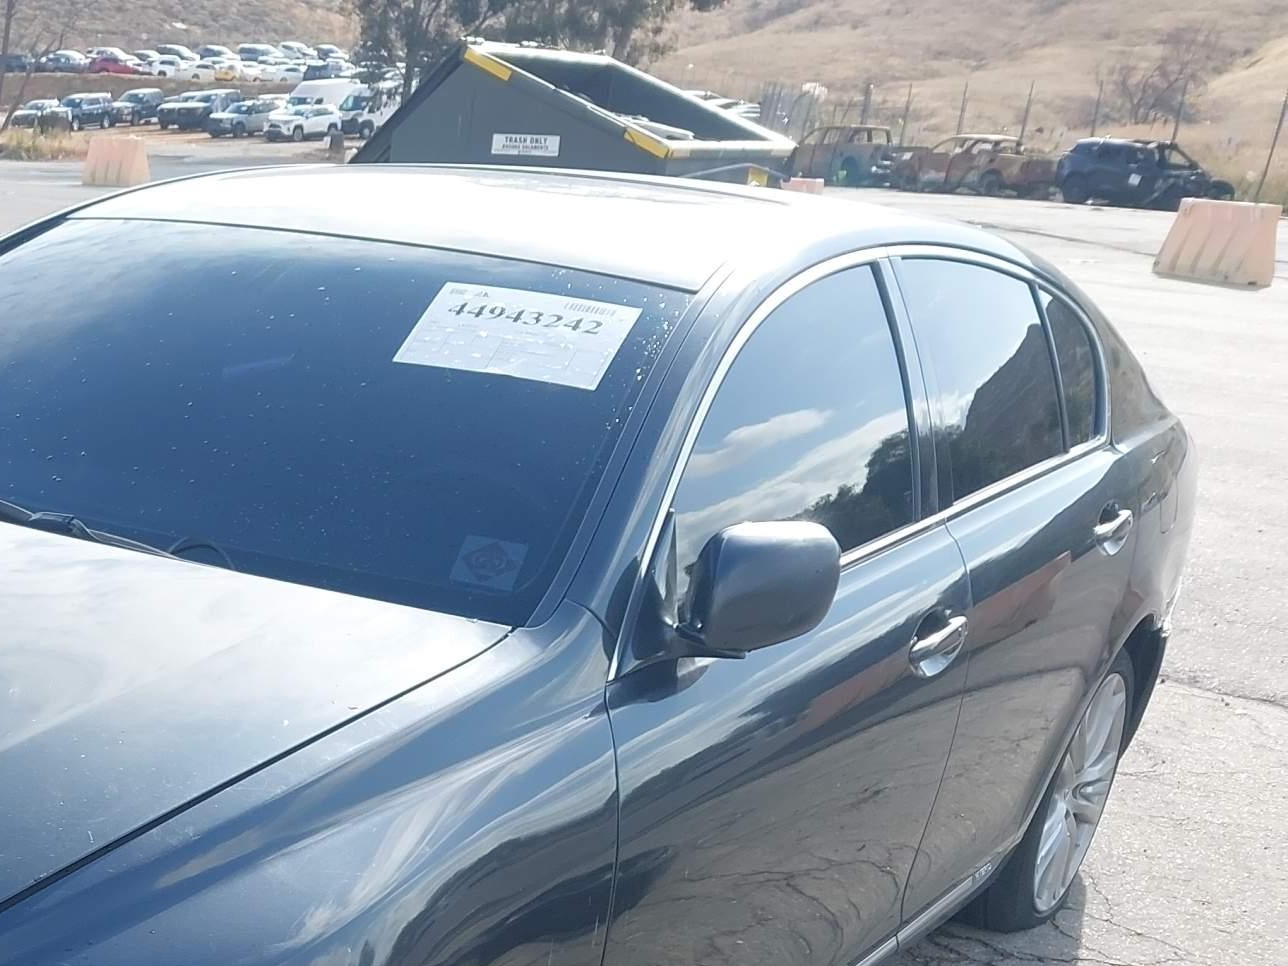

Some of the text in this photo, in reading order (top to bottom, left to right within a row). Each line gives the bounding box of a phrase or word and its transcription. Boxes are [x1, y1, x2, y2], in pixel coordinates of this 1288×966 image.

[505, 136, 548, 145] TRASH ONLY
[448, 301, 604, 335] 44943242
